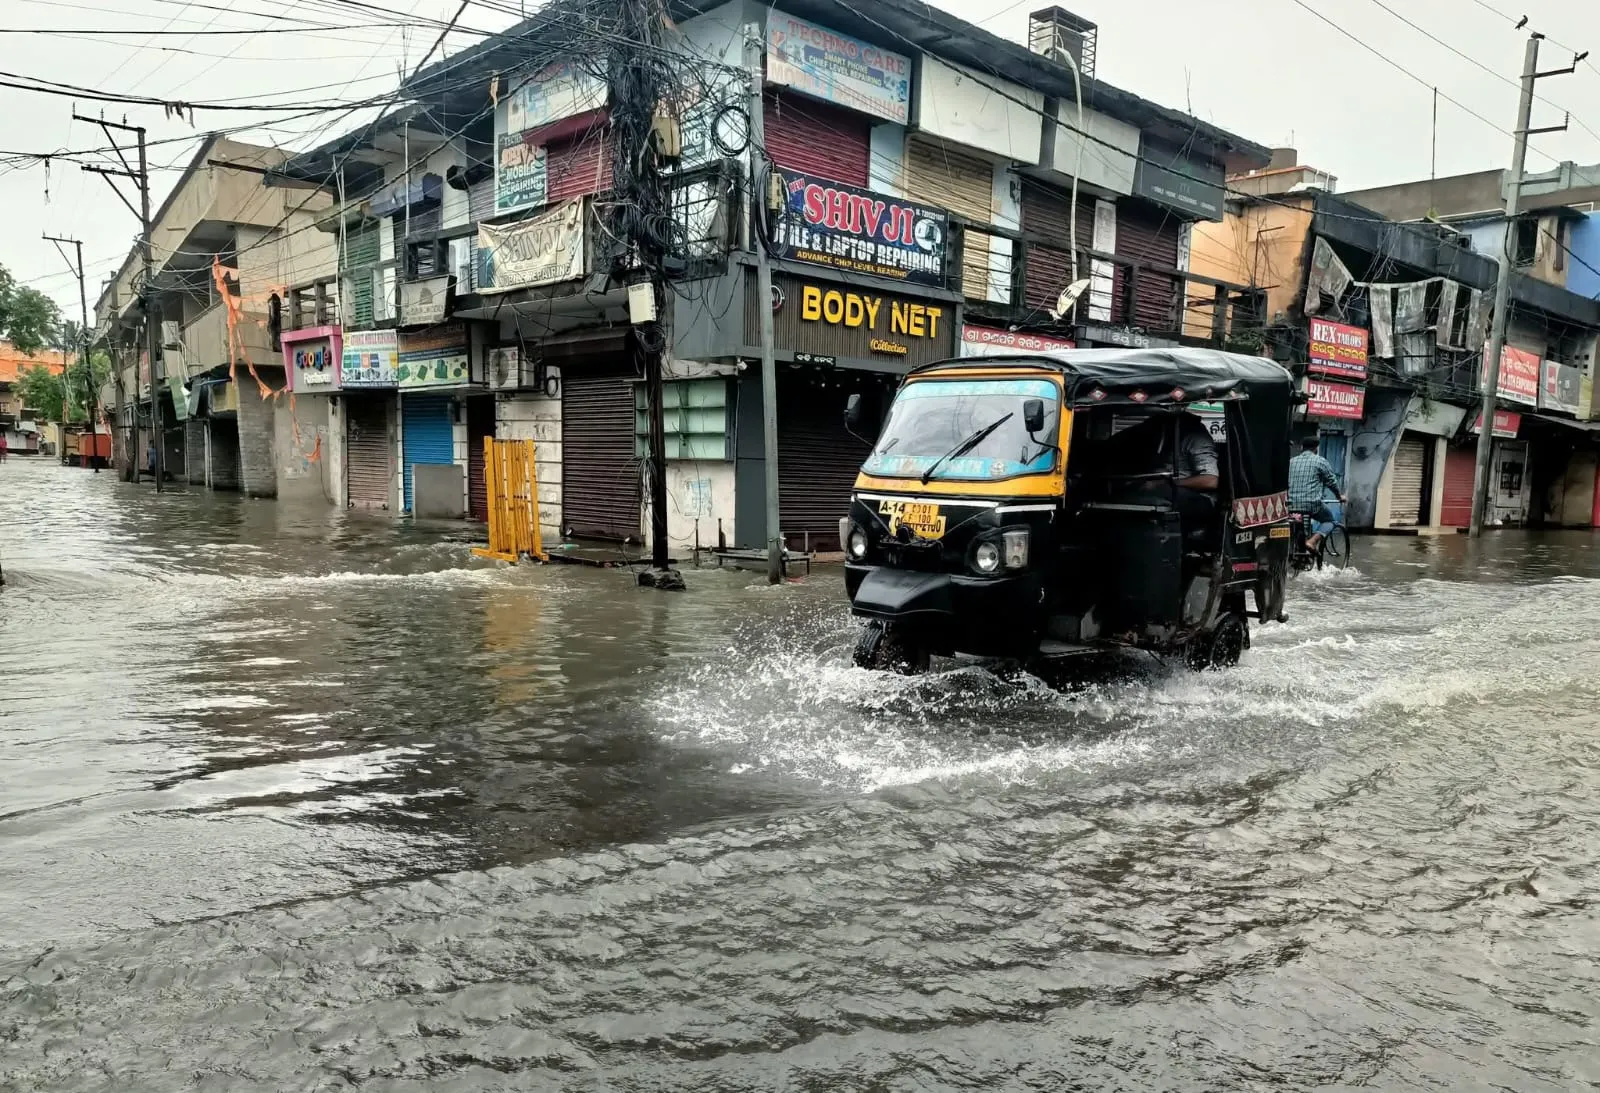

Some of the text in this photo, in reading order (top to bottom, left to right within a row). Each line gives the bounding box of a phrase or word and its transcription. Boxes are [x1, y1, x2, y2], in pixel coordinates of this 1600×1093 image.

[788, 20, 906, 75] TECHNO CARE
[847, 59, 868, 73] PHONE
[796, 250, 832, 264] ADVANCE
[853, 260, 876, 272] LEVEL
[812, 233, 824, 252] &
[825, 234, 875, 262] LAPTOP
[877, 245, 941, 274] REPAIRING
[802, 285, 942, 338] BODY NET
[870, 338, 908, 354] Collection
[1313, 323, 1362, 348] REX TAILORS
[295, 346, 332, 372] Google
[1308, 384, 1358, 406] REX TAILORS
[881, 501, 905, 513] A-14
